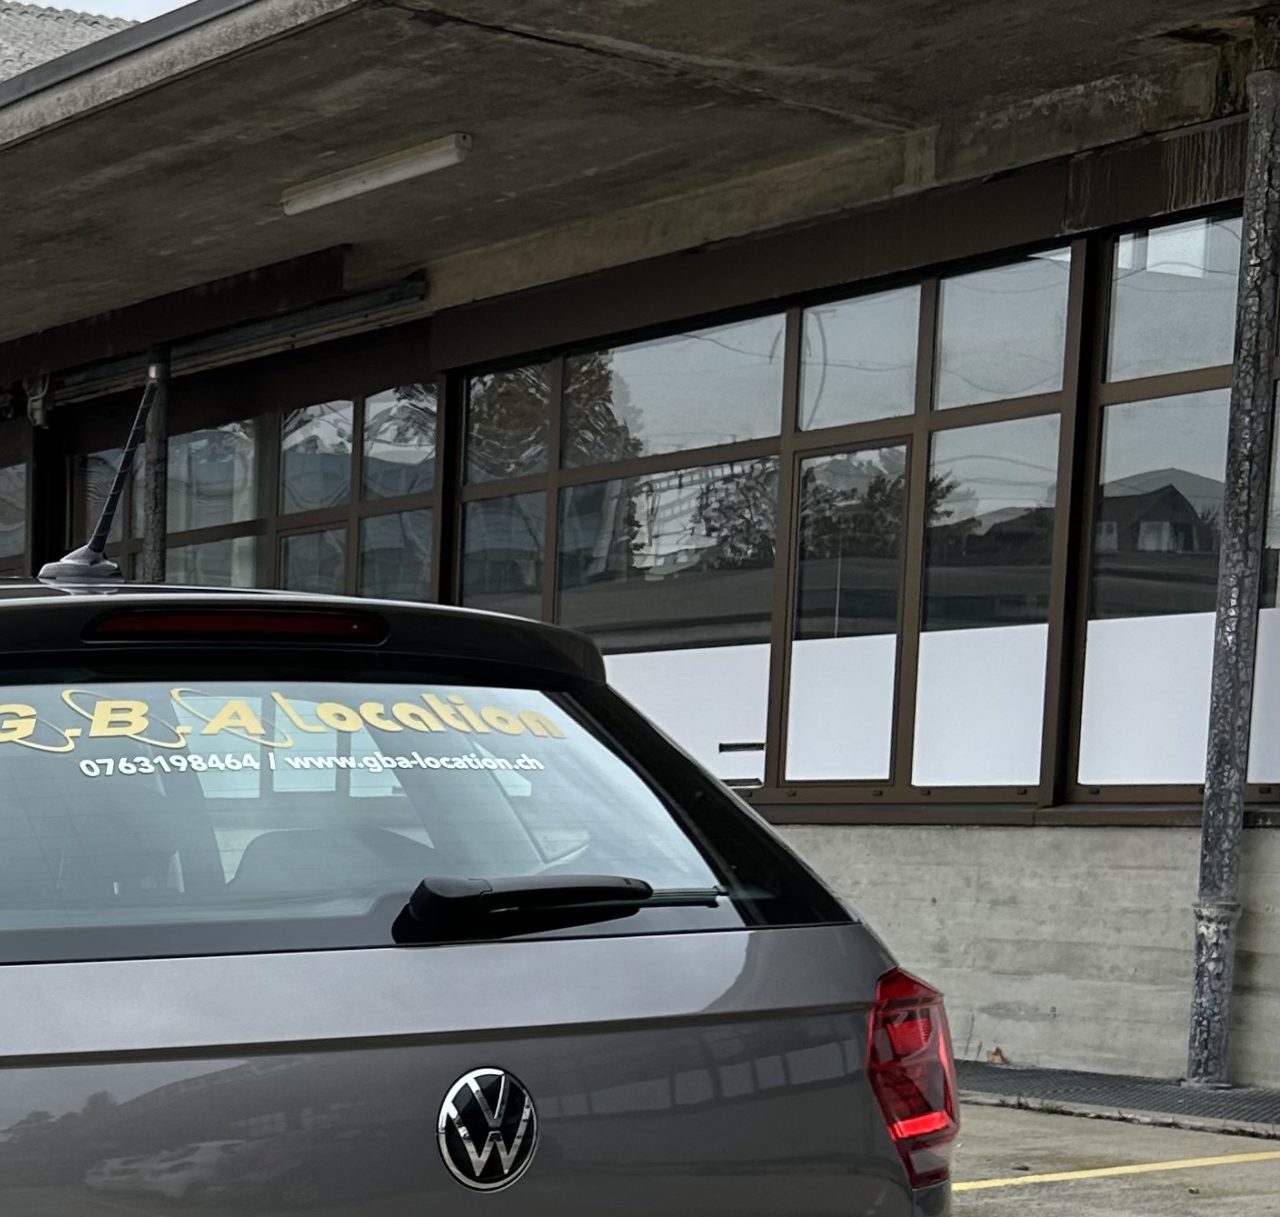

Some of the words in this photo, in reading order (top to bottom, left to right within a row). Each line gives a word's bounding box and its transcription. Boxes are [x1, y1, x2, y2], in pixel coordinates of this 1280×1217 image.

[271, 692, 567, 739] Location
[79, 751, 260, 777] 0763198464
[284, 751, 545, 773] www.gba-location.ch
